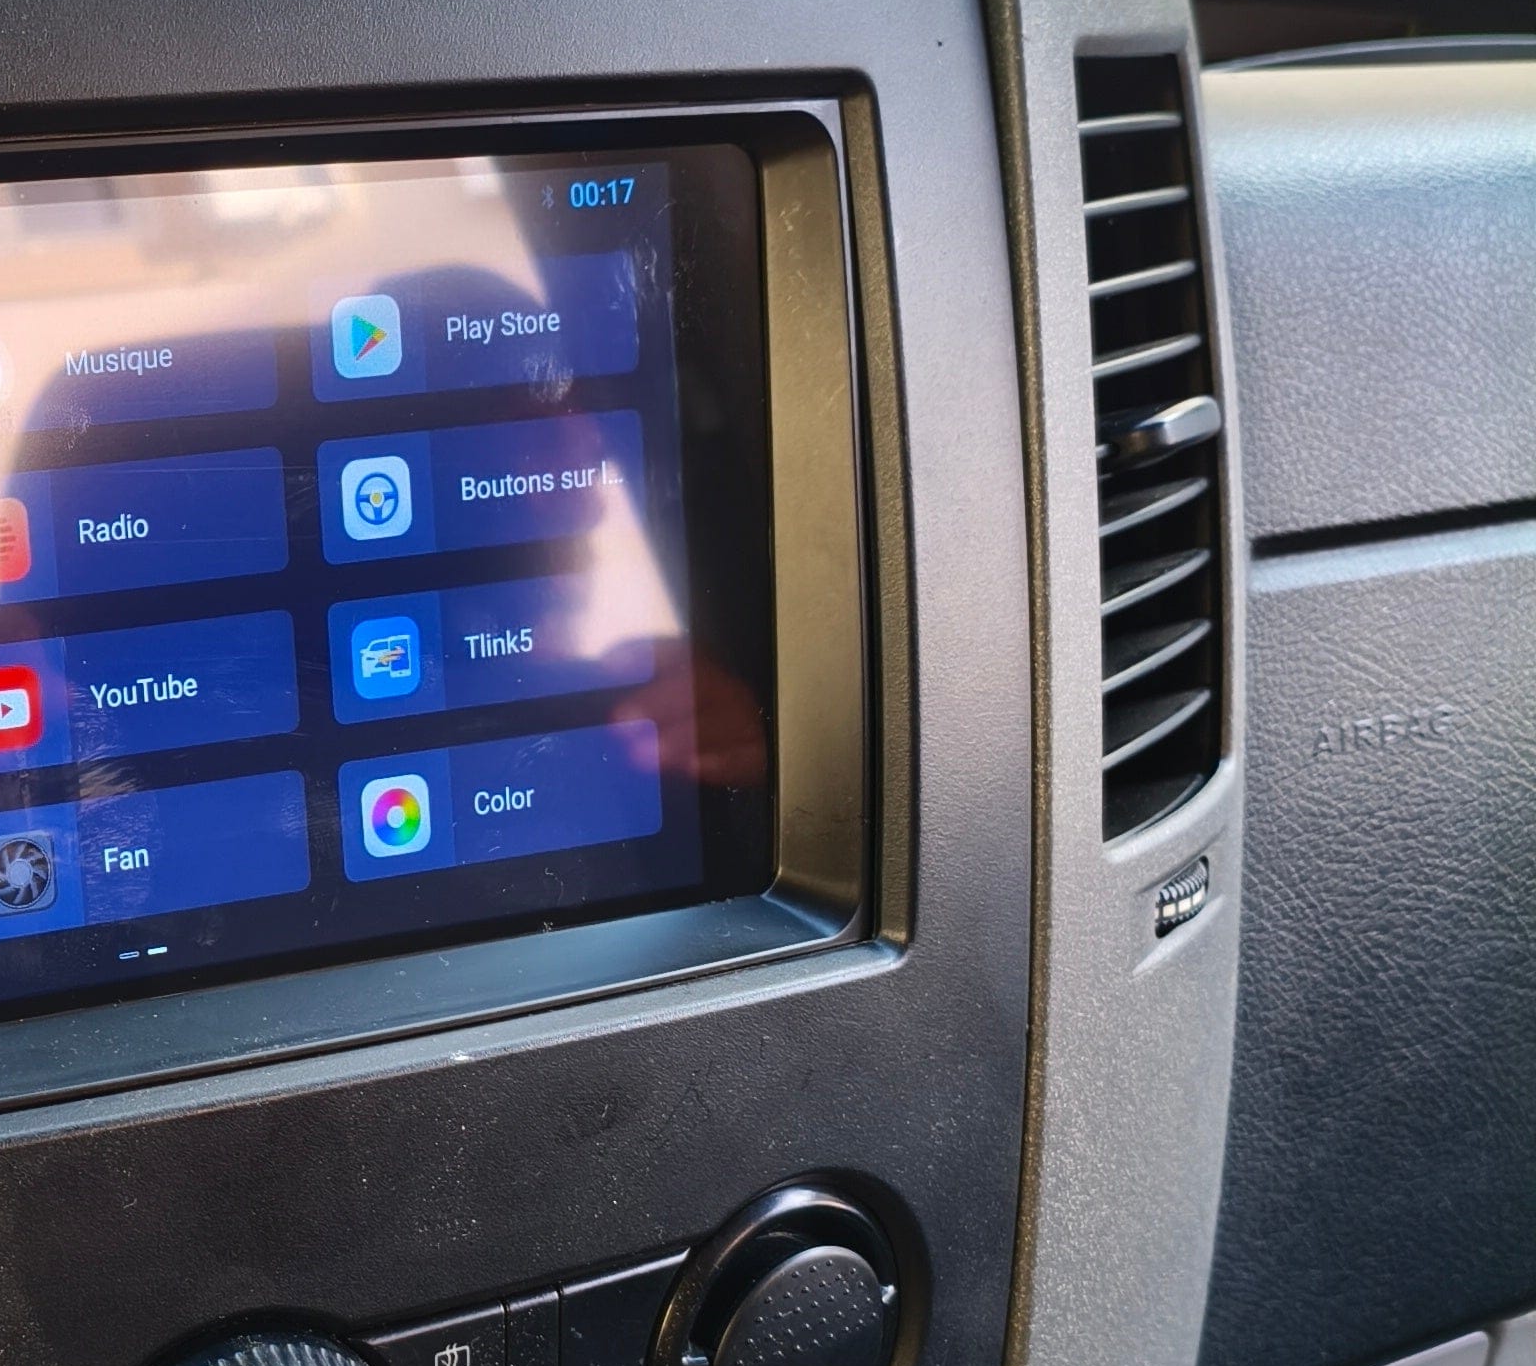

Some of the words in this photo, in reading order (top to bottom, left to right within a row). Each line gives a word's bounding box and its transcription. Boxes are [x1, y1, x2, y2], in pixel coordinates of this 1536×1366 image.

[570, 178, 635, 209] 00:17
[447, 314, 495, 345] Play
[499, 309, 561, 338] Store
[65, 345, 174, 378] Musique
[461, 473, 554, 501] Boutons
[561, 467, 596, 490] sur
[78, 514, 150, 545] Radio
[464, 628, 534, 662] Tlink5
[89, 673, 199, 710] YouTube
[473, 785, 535, 816] Color
[103, 845, 150, 874] Fan
